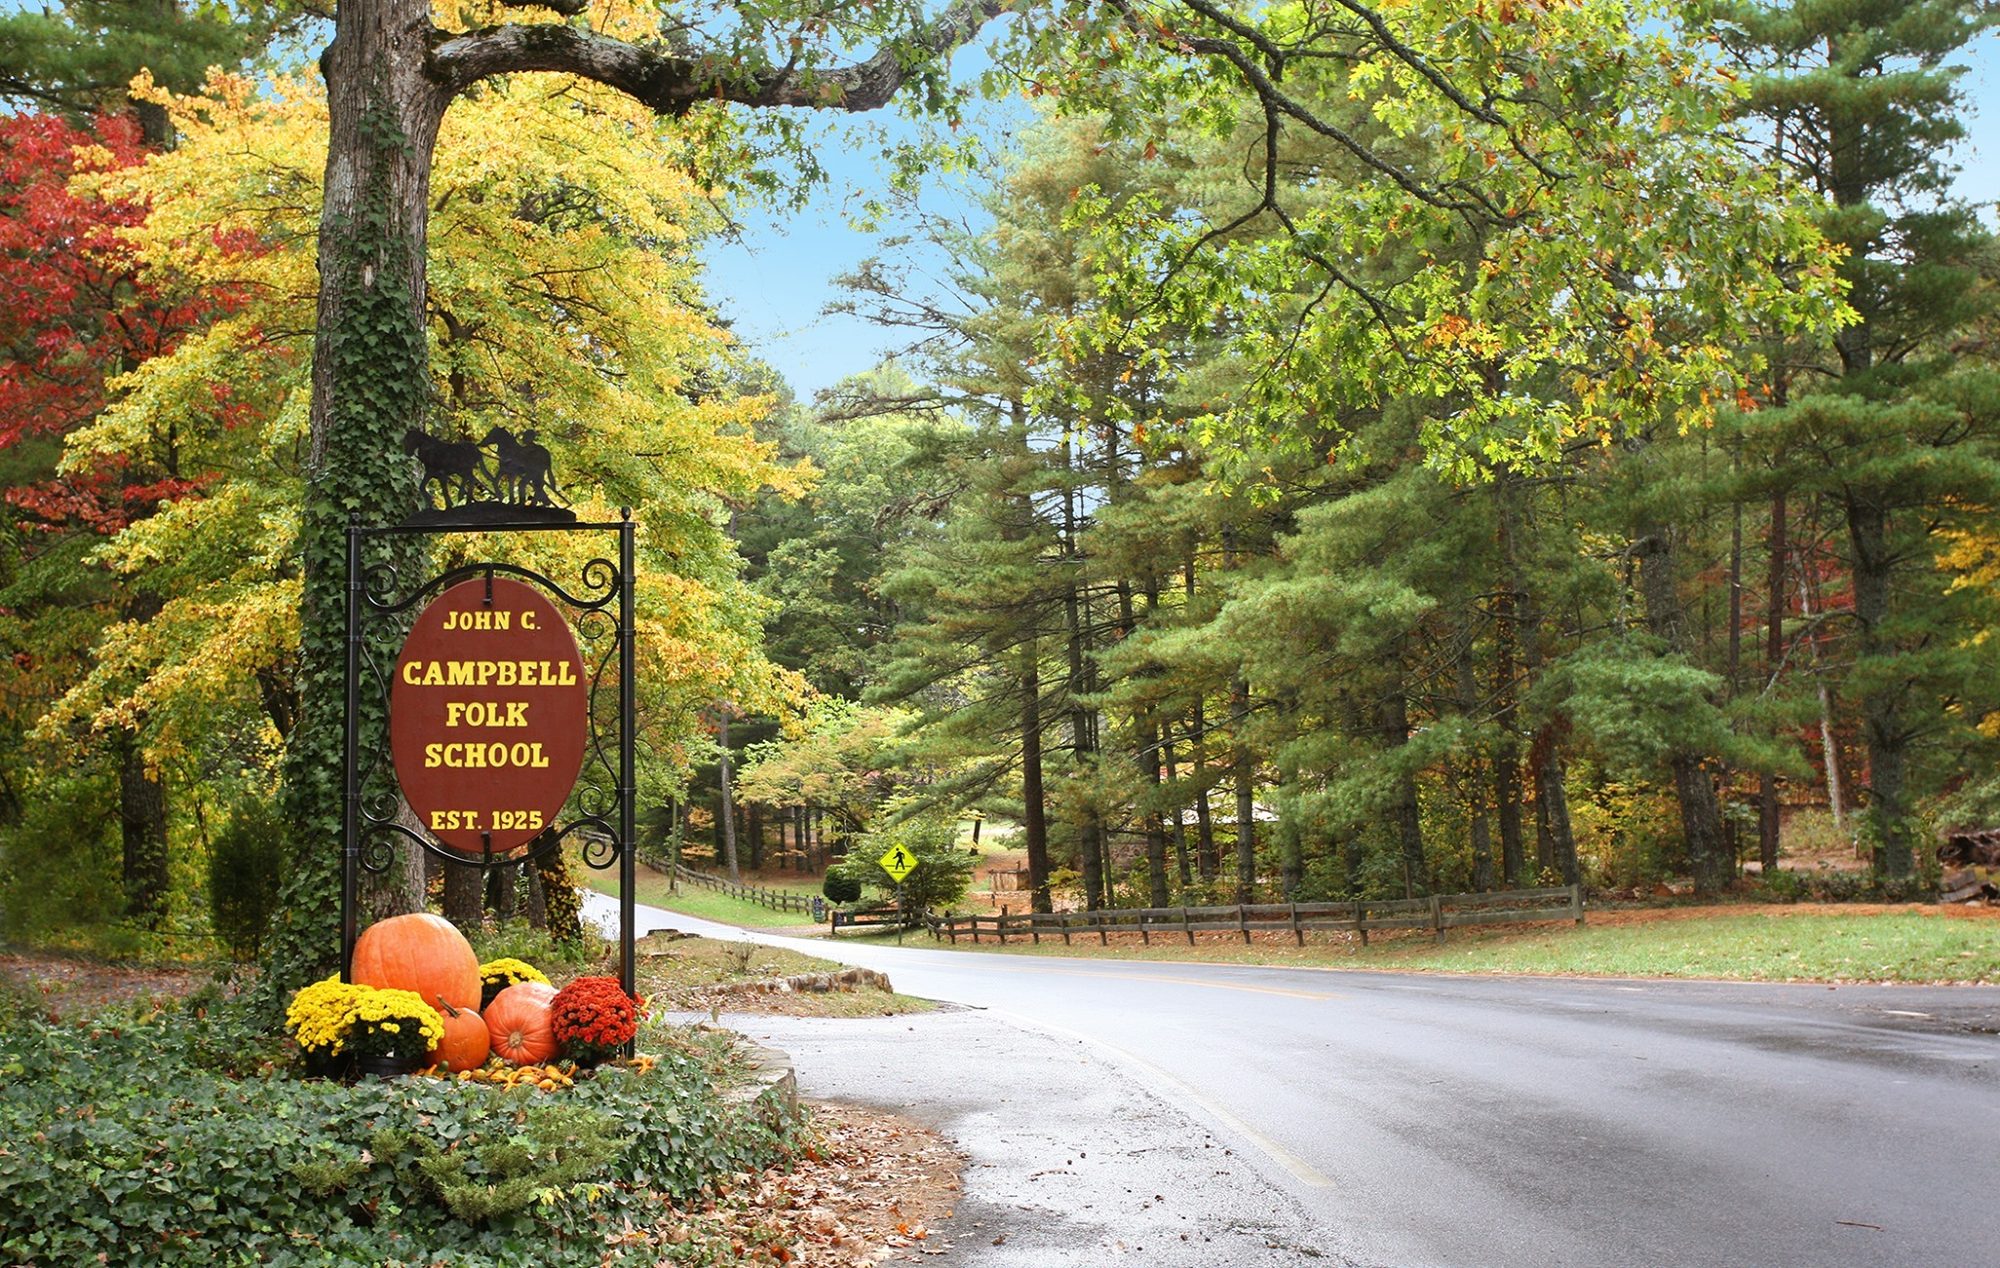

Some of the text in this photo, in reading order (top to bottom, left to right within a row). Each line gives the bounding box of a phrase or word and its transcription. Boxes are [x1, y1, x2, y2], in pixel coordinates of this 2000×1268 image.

[443, 610, 542, 631] JOHN C.
[402, 660, 577, 686] CAMPBELL
[445, 701, 530, 727] FOLK
[424, 742, 550, 768] SCHOOL
[430, 810, 544, 830] EST. 1925
